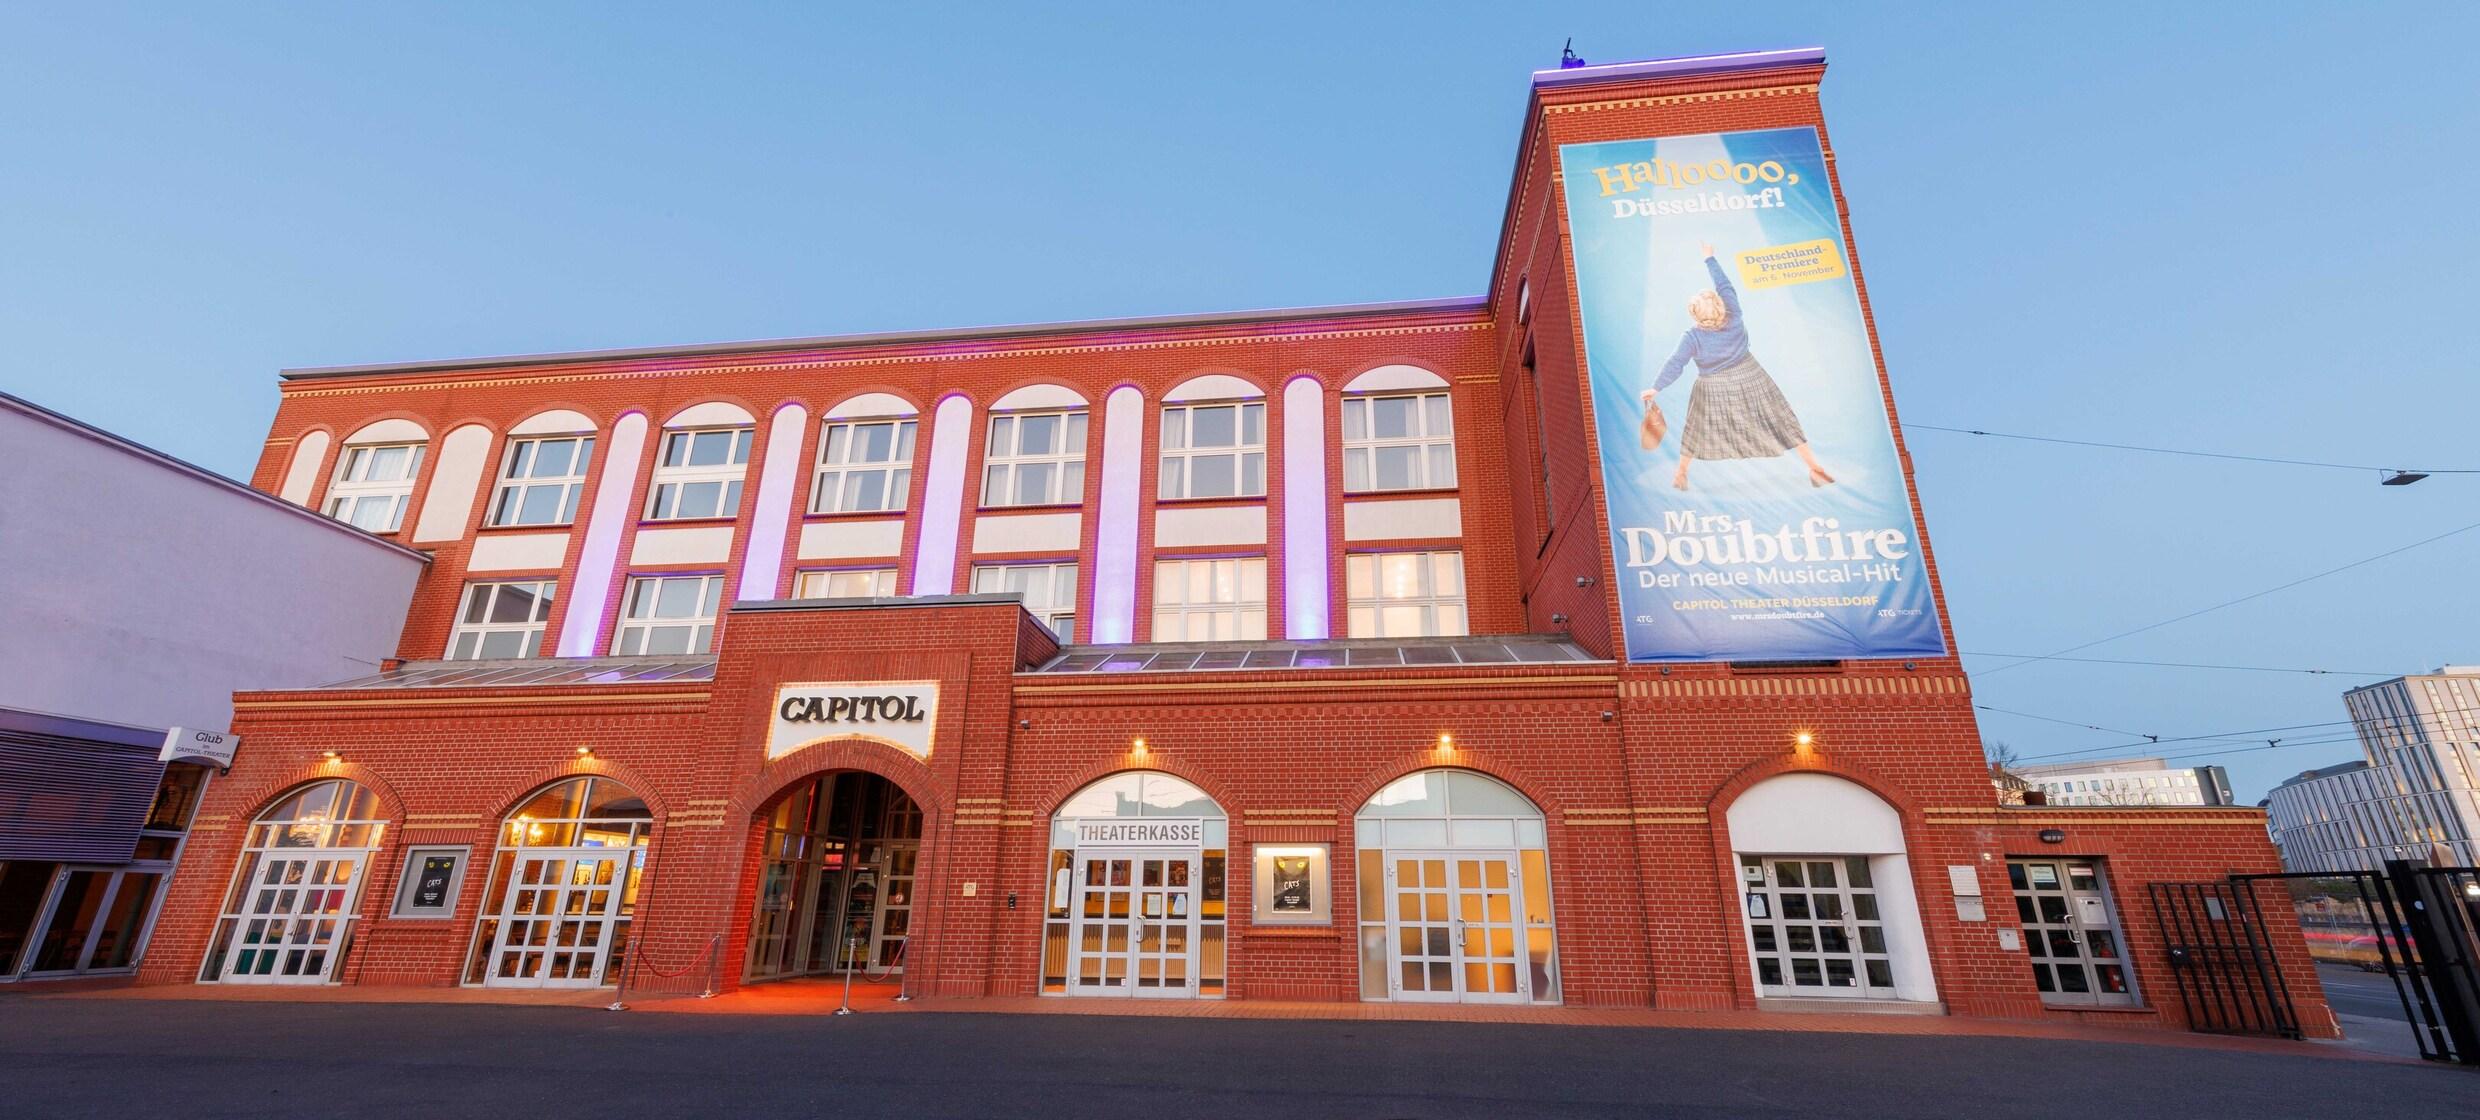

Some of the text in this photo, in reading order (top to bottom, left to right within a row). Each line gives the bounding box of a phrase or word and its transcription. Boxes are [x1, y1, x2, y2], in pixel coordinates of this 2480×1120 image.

[1591, 158, 1800, 197] Halloooo,
[1611, 187, 1785, 219] Düsseldorf!
[1744, 245, 1828, 264] Deutschland-
[1760, 257, 1819, 272] Premiere
[1752, 275, 1769, 284] am
[1782, 266, 1835, 280] November
[1663, 509, 1737, 535] Mrs.
[1621, 517, 1910, 568] Doubtfire
[1638, 563, 1903, 588] Der neue Musical-Hit
[1672, 595, 1879, 611] CAPITOL THEATER DÜSSELDORF
[780, 695, 926, 723] CAPITOL
[195, 732, 223, 744] Club
[1079, 824, 1200, 841] THEATERKASSE
[1283, 879, 1300, 891] CATS
